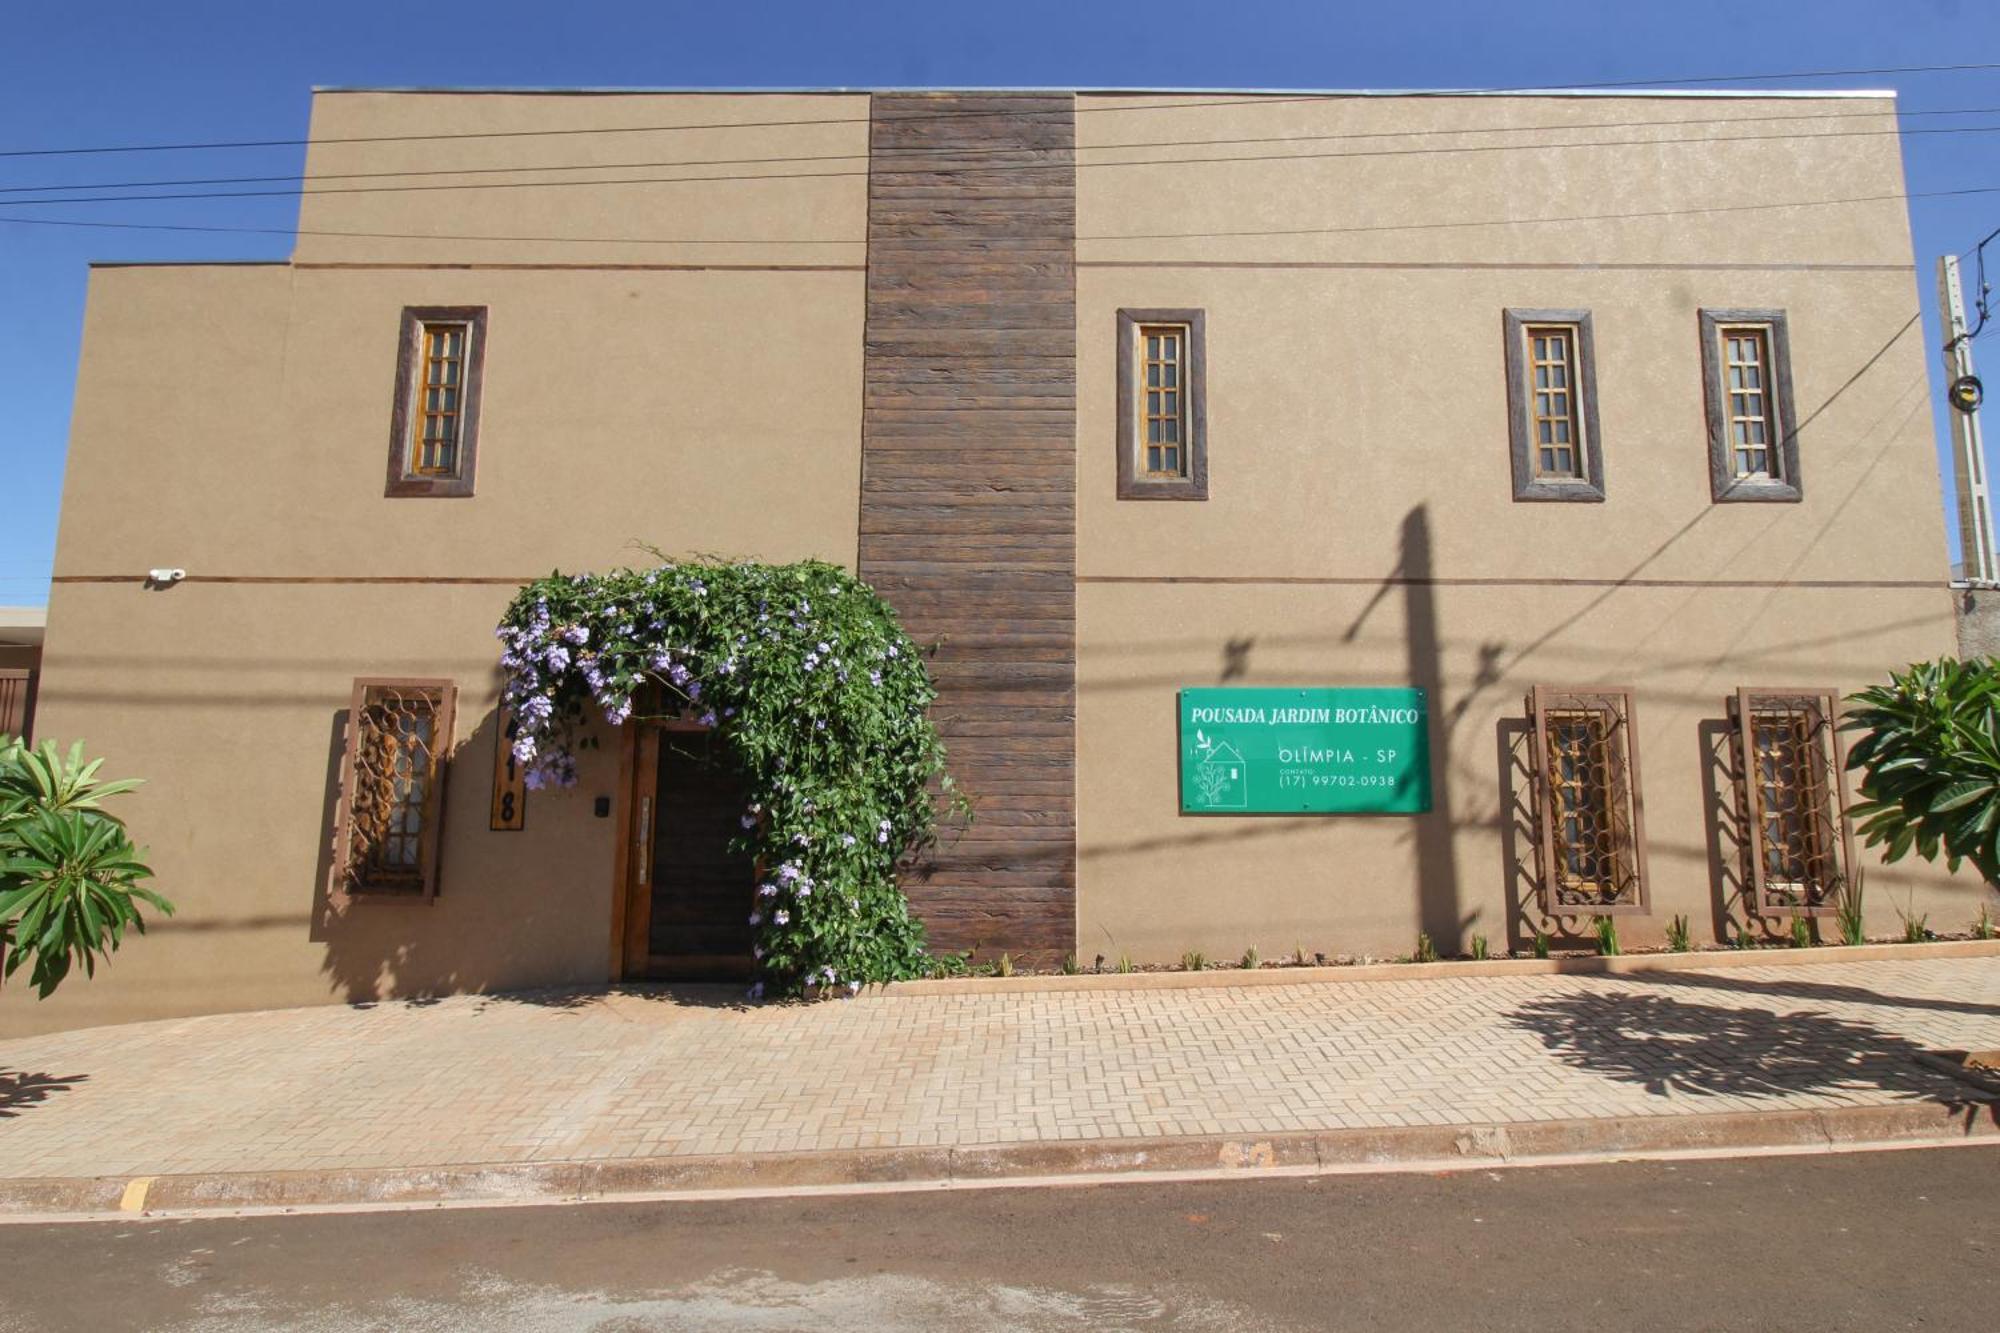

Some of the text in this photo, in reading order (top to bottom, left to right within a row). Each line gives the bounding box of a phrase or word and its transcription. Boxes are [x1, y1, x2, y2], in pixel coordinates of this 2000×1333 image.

[1191, 704, 1419, 725] POUSADA JARDIM BOTÂNICO
[1279, 746, 1354, 763] OLÍMPIA
[1376, 749, 1397, 763] SP
[1279, 775, 1396, 788] (17) 99702-0938
